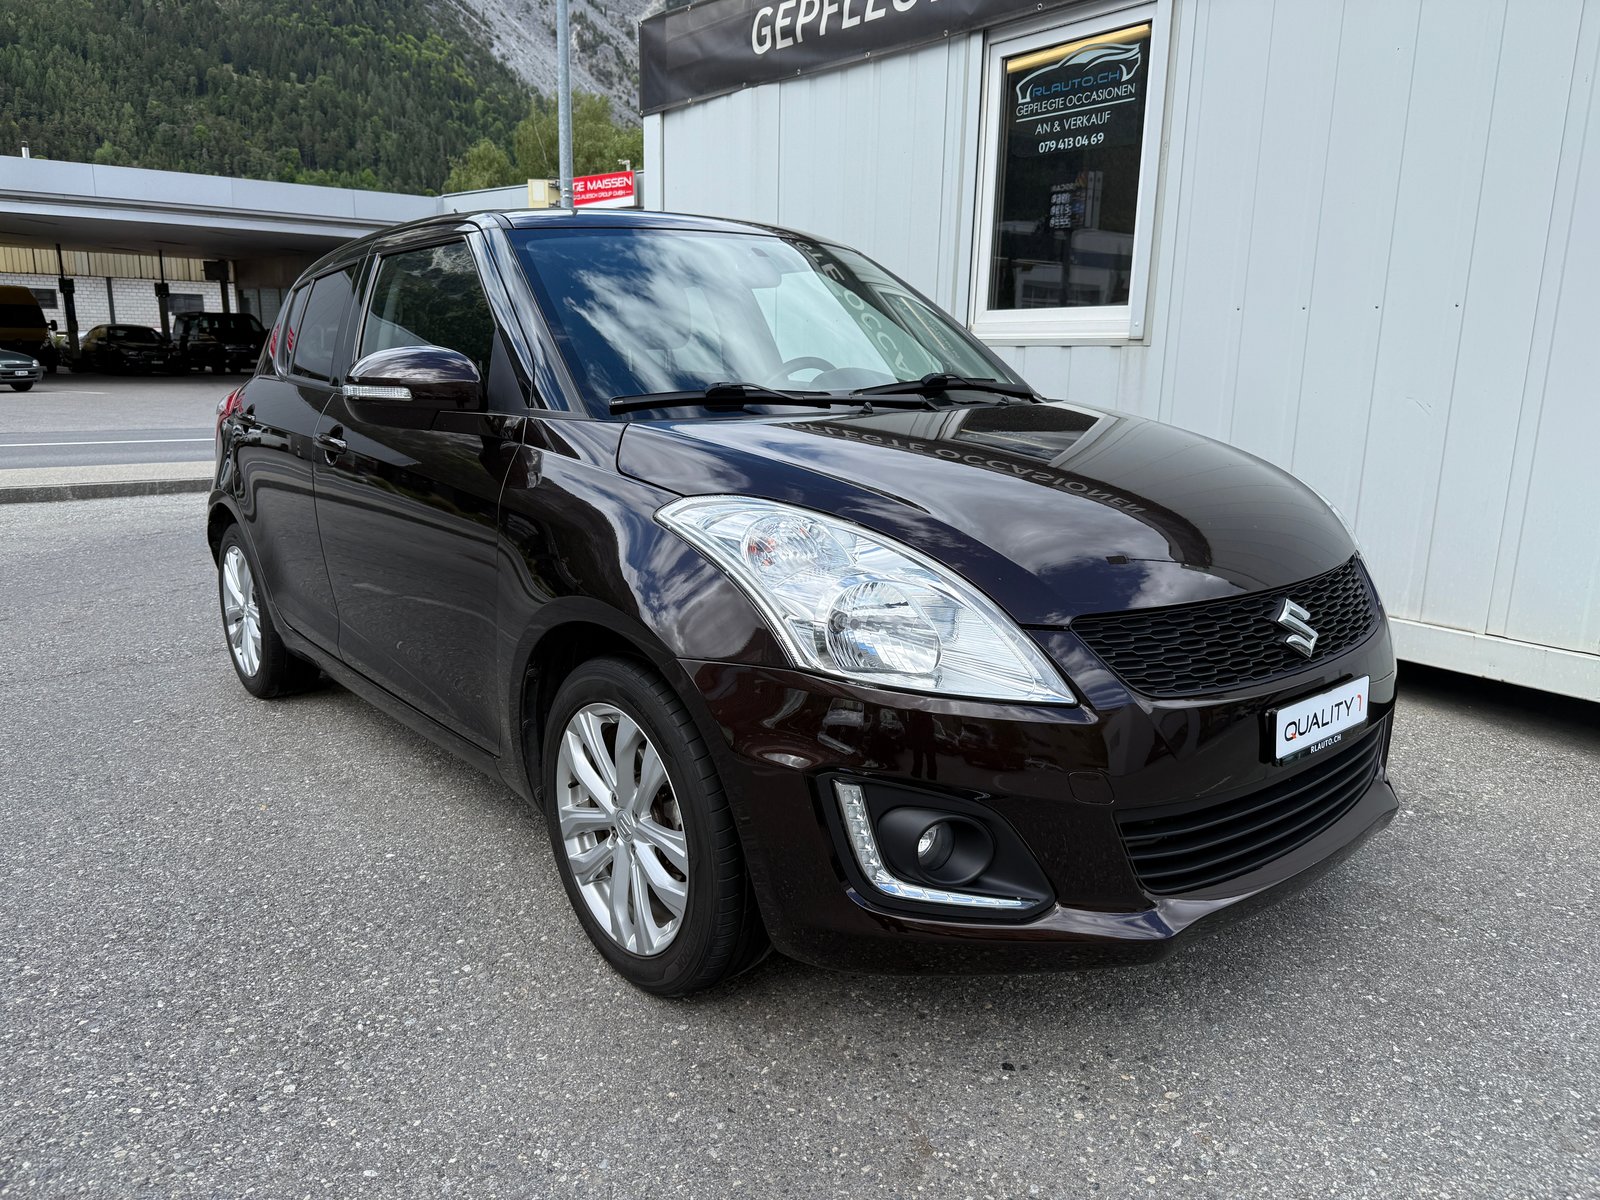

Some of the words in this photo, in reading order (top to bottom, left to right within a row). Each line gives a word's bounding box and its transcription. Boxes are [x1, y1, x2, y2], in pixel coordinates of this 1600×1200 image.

[1032, 70, 1120, 97] RLAUTO.CH
[1016, 98, 1065, 117] GEPFLEGTE
[1066, 83, 1136, 107] OCCASIONEN
[1035, 122, 1051, 136] AN
[1053, 121, 1061, 132] &
[1064, 111, 1111, 130] VERKAUF
[1039, 141, 1056, 153] 079
[1058, 138, 1073, 150] 413
[1075, 136, 1088, 147] 04
[1090, 132, 1104, 145] 69
[572, 181, 585, 192] GE
[587, 177, 632, 190] MAISSEN
[1310, 734, 1342, 754] RLAUTO.CH
